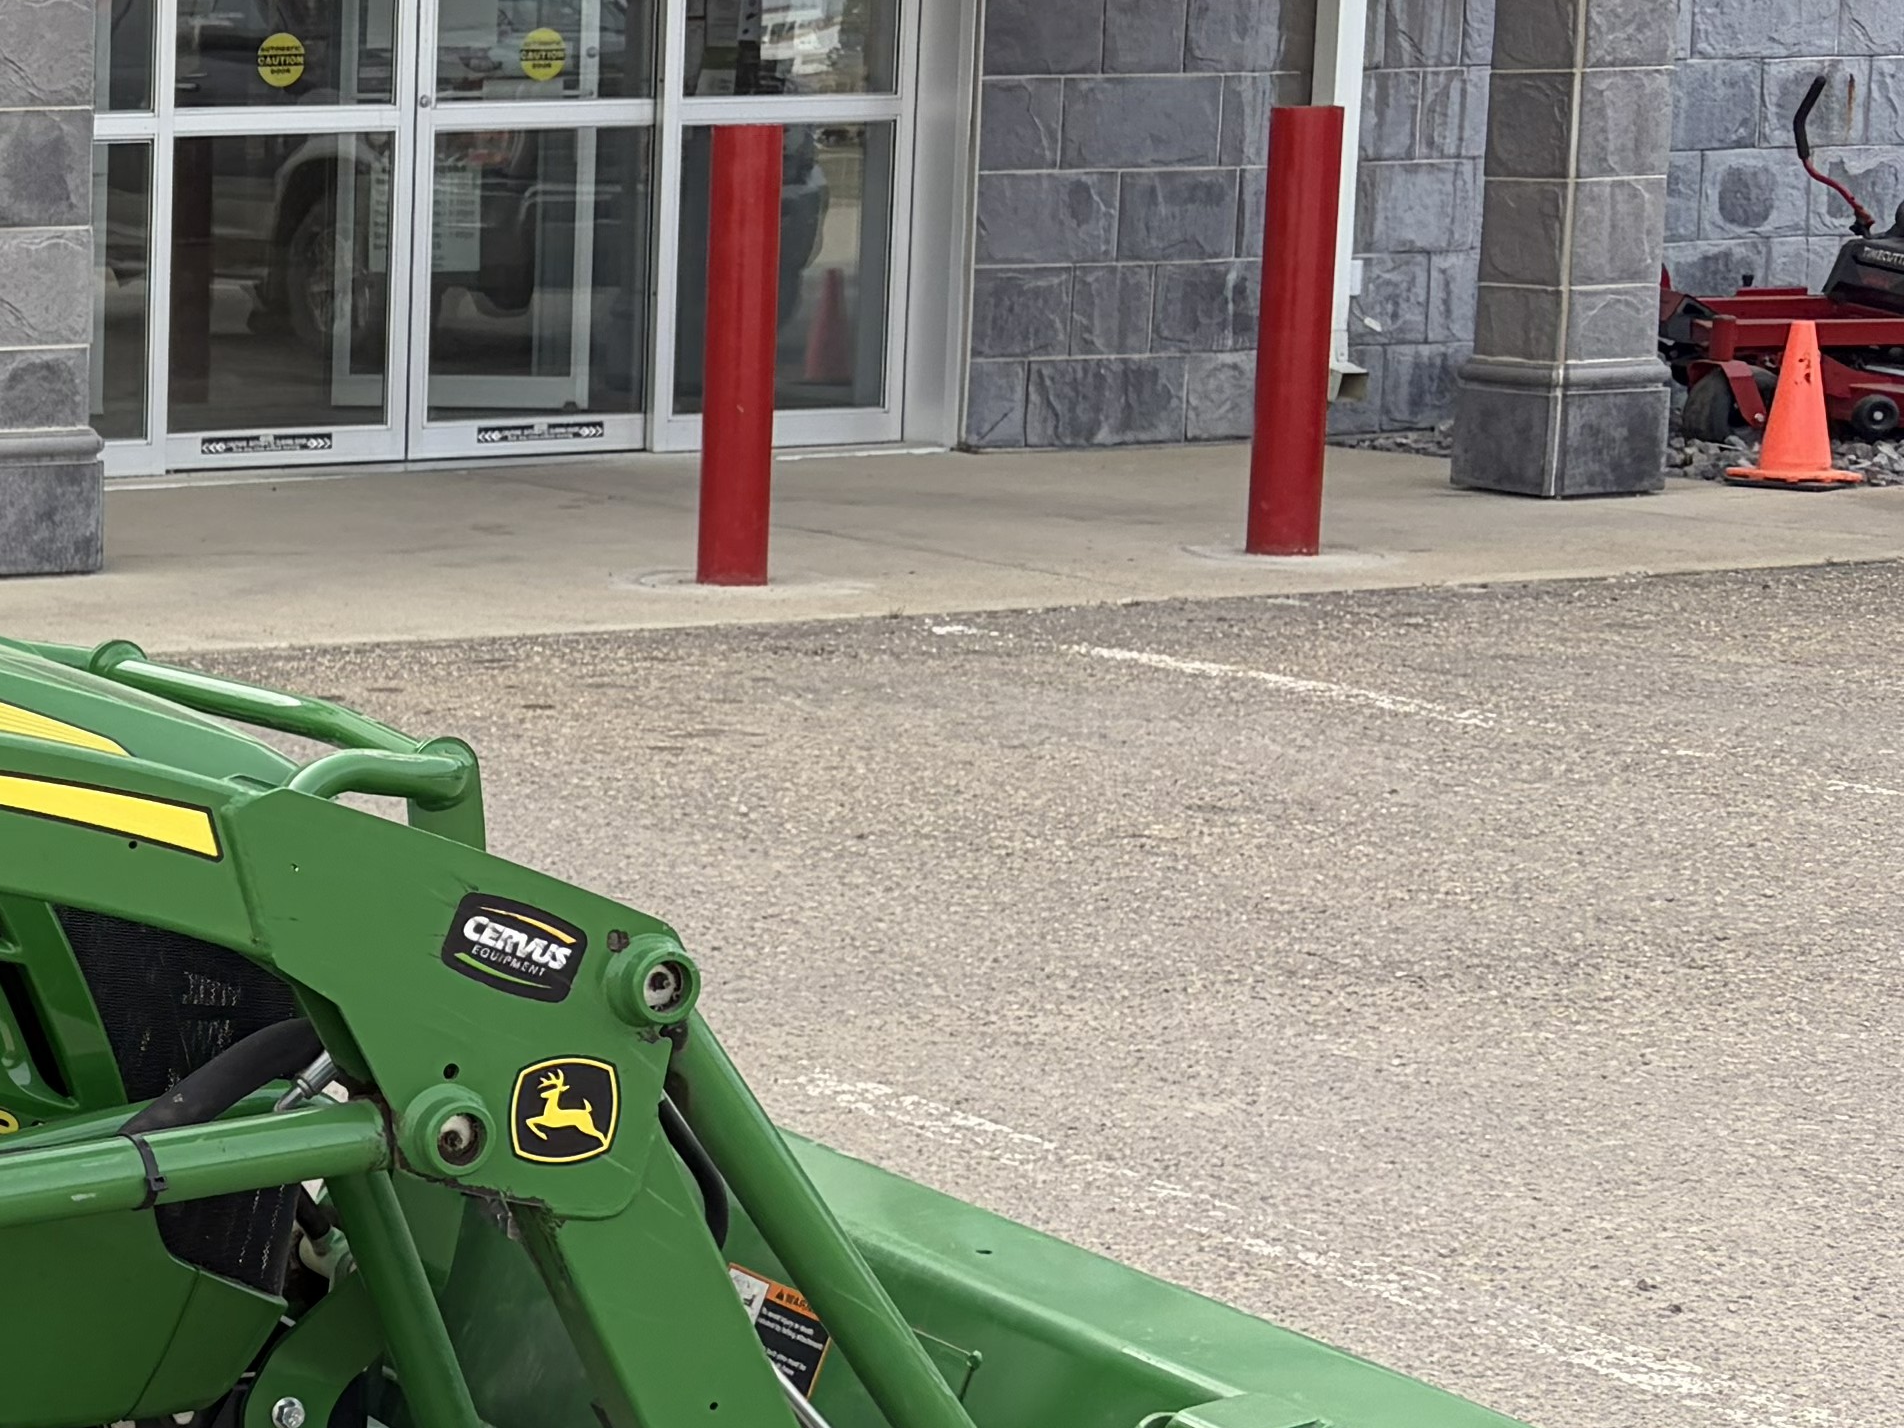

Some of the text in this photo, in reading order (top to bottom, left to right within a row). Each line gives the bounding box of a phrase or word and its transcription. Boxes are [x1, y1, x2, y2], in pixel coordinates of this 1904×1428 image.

[258, 55, 304, 65] CAUTION
[521, 51, 564, 60] CAUTION
[463, 916, 572, 970] CERVUS
[472, 944, 546, 976] EQUIPMENT
